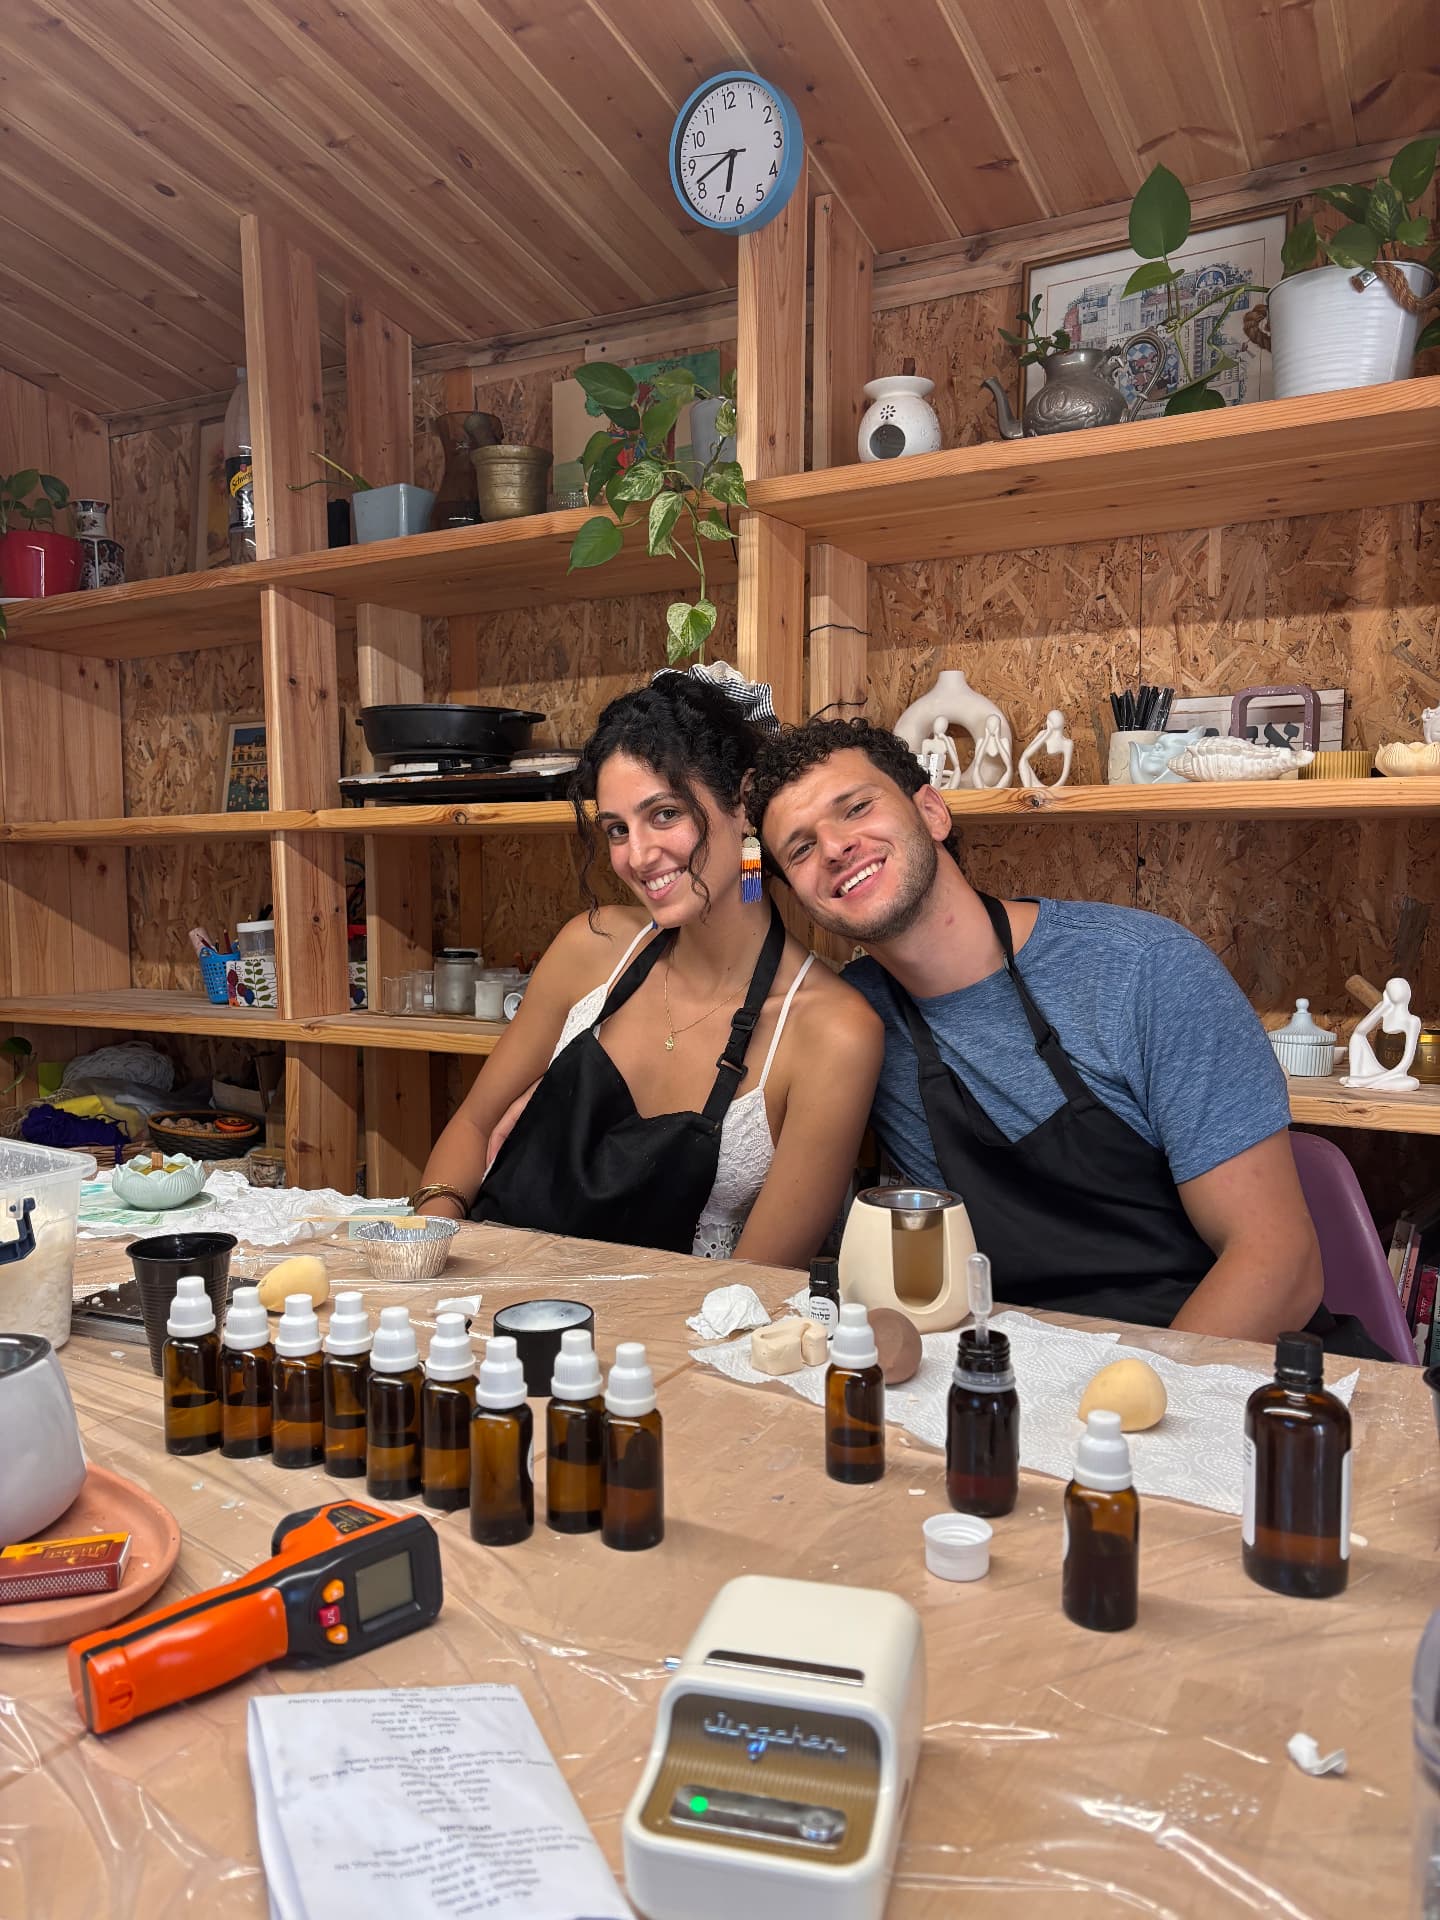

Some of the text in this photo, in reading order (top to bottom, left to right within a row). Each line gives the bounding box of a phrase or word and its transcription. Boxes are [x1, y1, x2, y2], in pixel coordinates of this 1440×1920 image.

[722, 91, 736, 110] 12
[748, 92, 753, 109] 1
[704, 108, 715, 126] 11
[763, 106, 773, 124] 2
[692, 131, 705, 149] 10
[773, 131, 783, 149] 3
[688, 159, 696, 176] 9
[768, 160, 778, 177] 4
[698, 182, 707, 199] 8
[755, 183, 765, 201] 5
[717, 194, 726, 214] 7
[735, 196, 745, 215] 6
